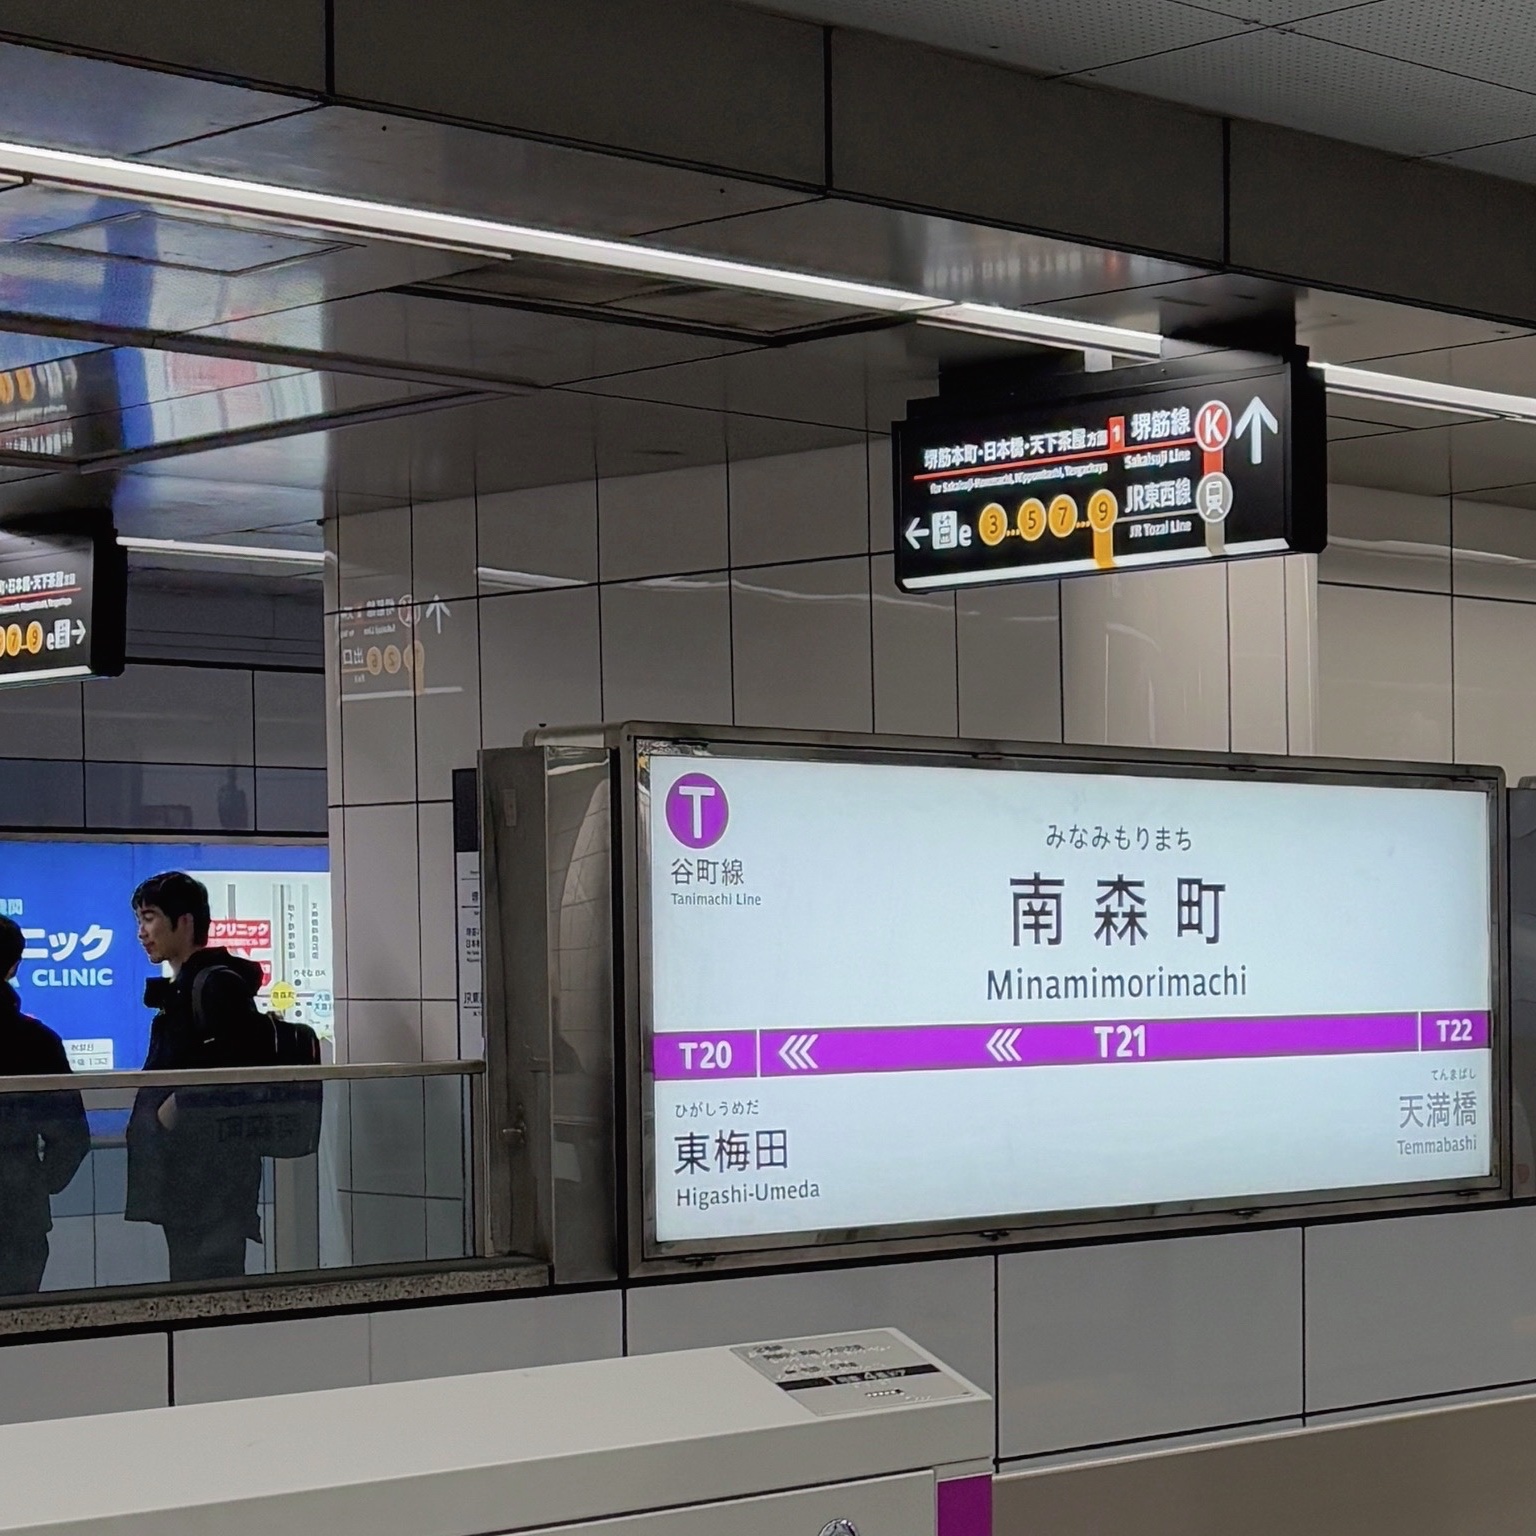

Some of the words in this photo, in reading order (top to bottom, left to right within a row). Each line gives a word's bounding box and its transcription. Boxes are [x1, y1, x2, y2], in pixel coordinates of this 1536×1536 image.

[1112, 425, 1121, 442] 1
[1205, 408, 1223, 444] K
[1125, 477, 1191, 513] JR東西線
[1028, 511, 1037, 529] 5
[1058, 506, 1067, 526] 7
[1099, 501, 1108, 521] 9
[959, 524, 972, 547] e
[989, 515, 998, 534] 3
[679, 786, 715, 838] T
[1046, 824, 1192, 851] みなみもりまち
[671, 858, 744, 886] 谷町線
[671, 892, 732, 905] Tanimachi
[736, 892, 762, 905] Line
[1010, 872, 1226, 947] 南森町
[32, 968, 113, 987] CLINIC
[987, 965, 1247, 1000] Minamimorimachi
[1094, 1025, 1147, 1058] T21
[1436, 1018, 1473, 1042] T22
[679, 1040, 732, 1069] T20
[1431, 1068, 1477, 1081] てんまばし
[675, 1100, 759, 1118] ひがしうめだ
[1399, 1091, 1477, 1129] 天満橋
[674, 1129, 788, 1175] 東梅田
[1397, 1136, 1477, 1155] Temmabashi
[677, 1179, 820, 1210] Higashi-Umeda
